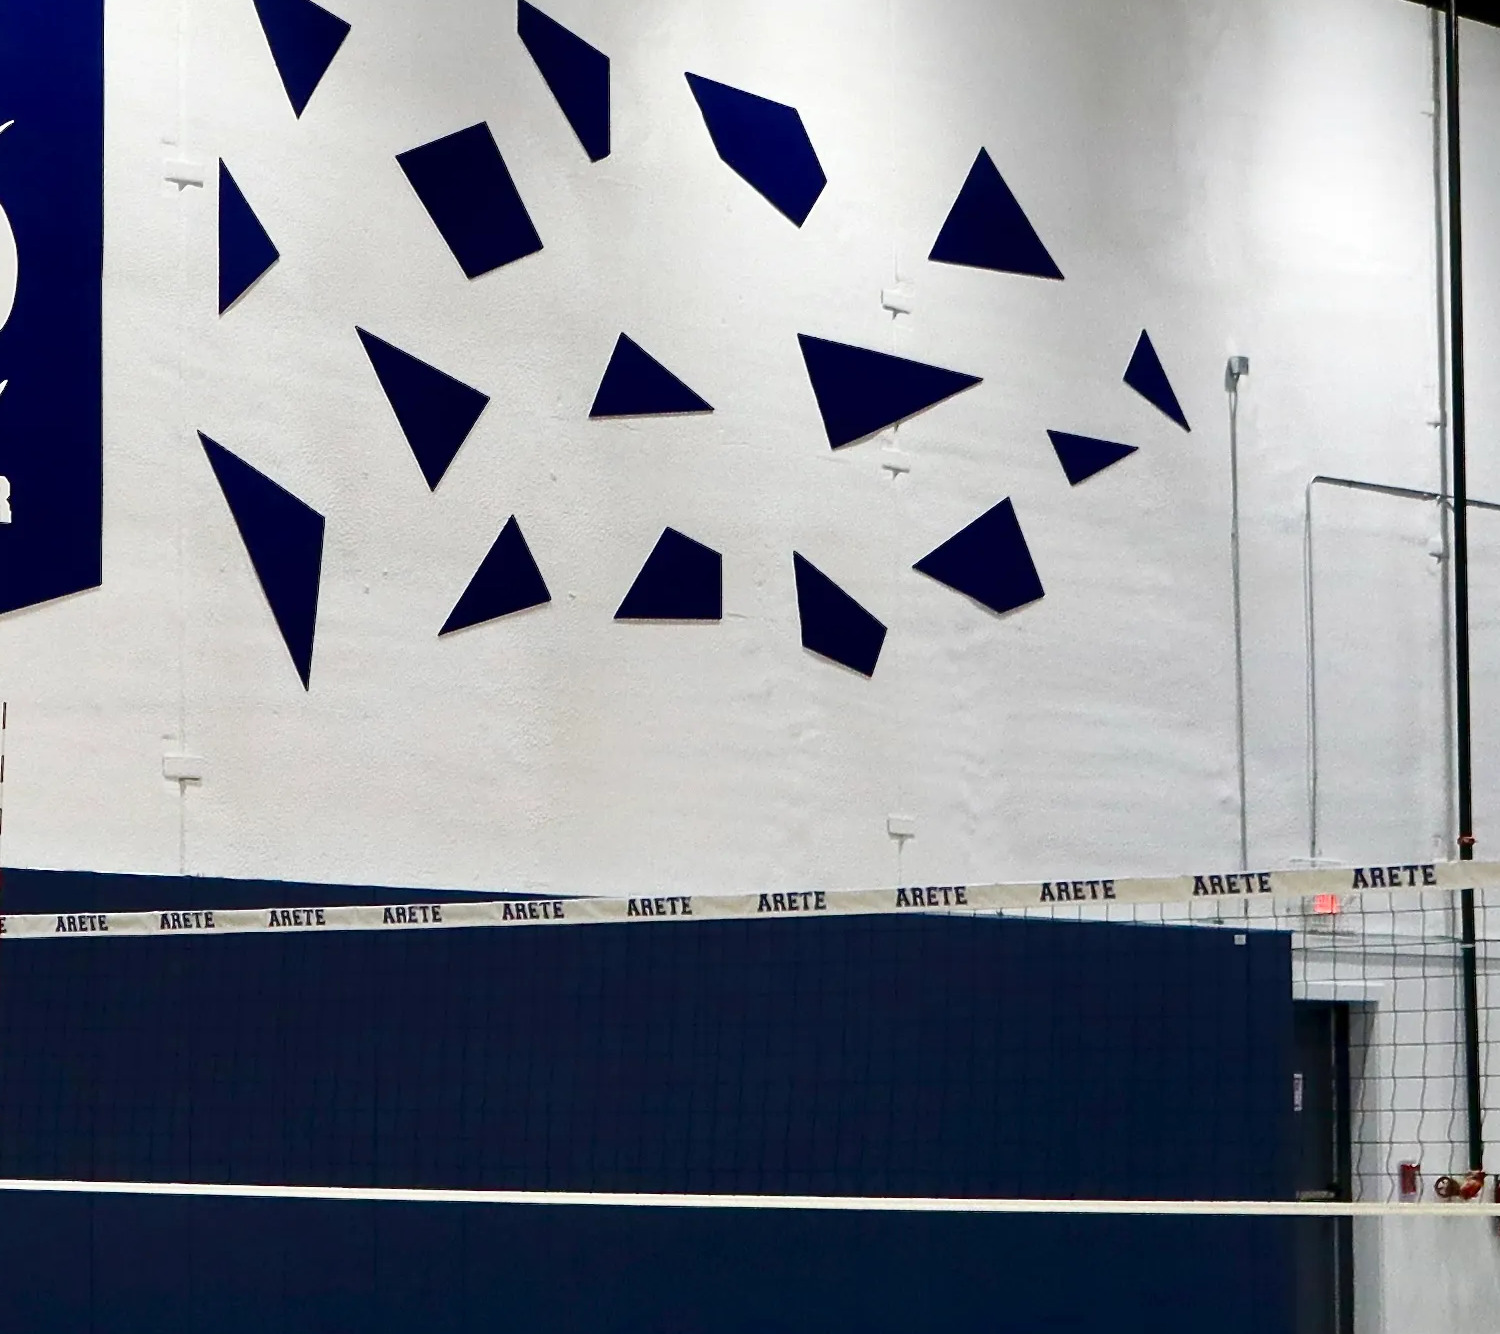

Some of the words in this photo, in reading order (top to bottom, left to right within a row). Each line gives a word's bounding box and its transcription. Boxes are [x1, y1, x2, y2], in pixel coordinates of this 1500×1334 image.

[55, 915, 108, 932] ARETE
[159, 911, 216, 929] ARETE
[268, 908, 326, 927] ARETE
[382, 906, 442, 925] ARETE
[501, 901, 565, 921] ARETE
[626, 896, 693, 916] ARETE
[757, 891, 827, 912] ARETE
[896, 886, 968, 907] ARETE
[1040, 879, 1116, 902] ARETE
[1193, 872, 1272, 896] ARETE
[1352, 864, 1437, 889] ARETE
